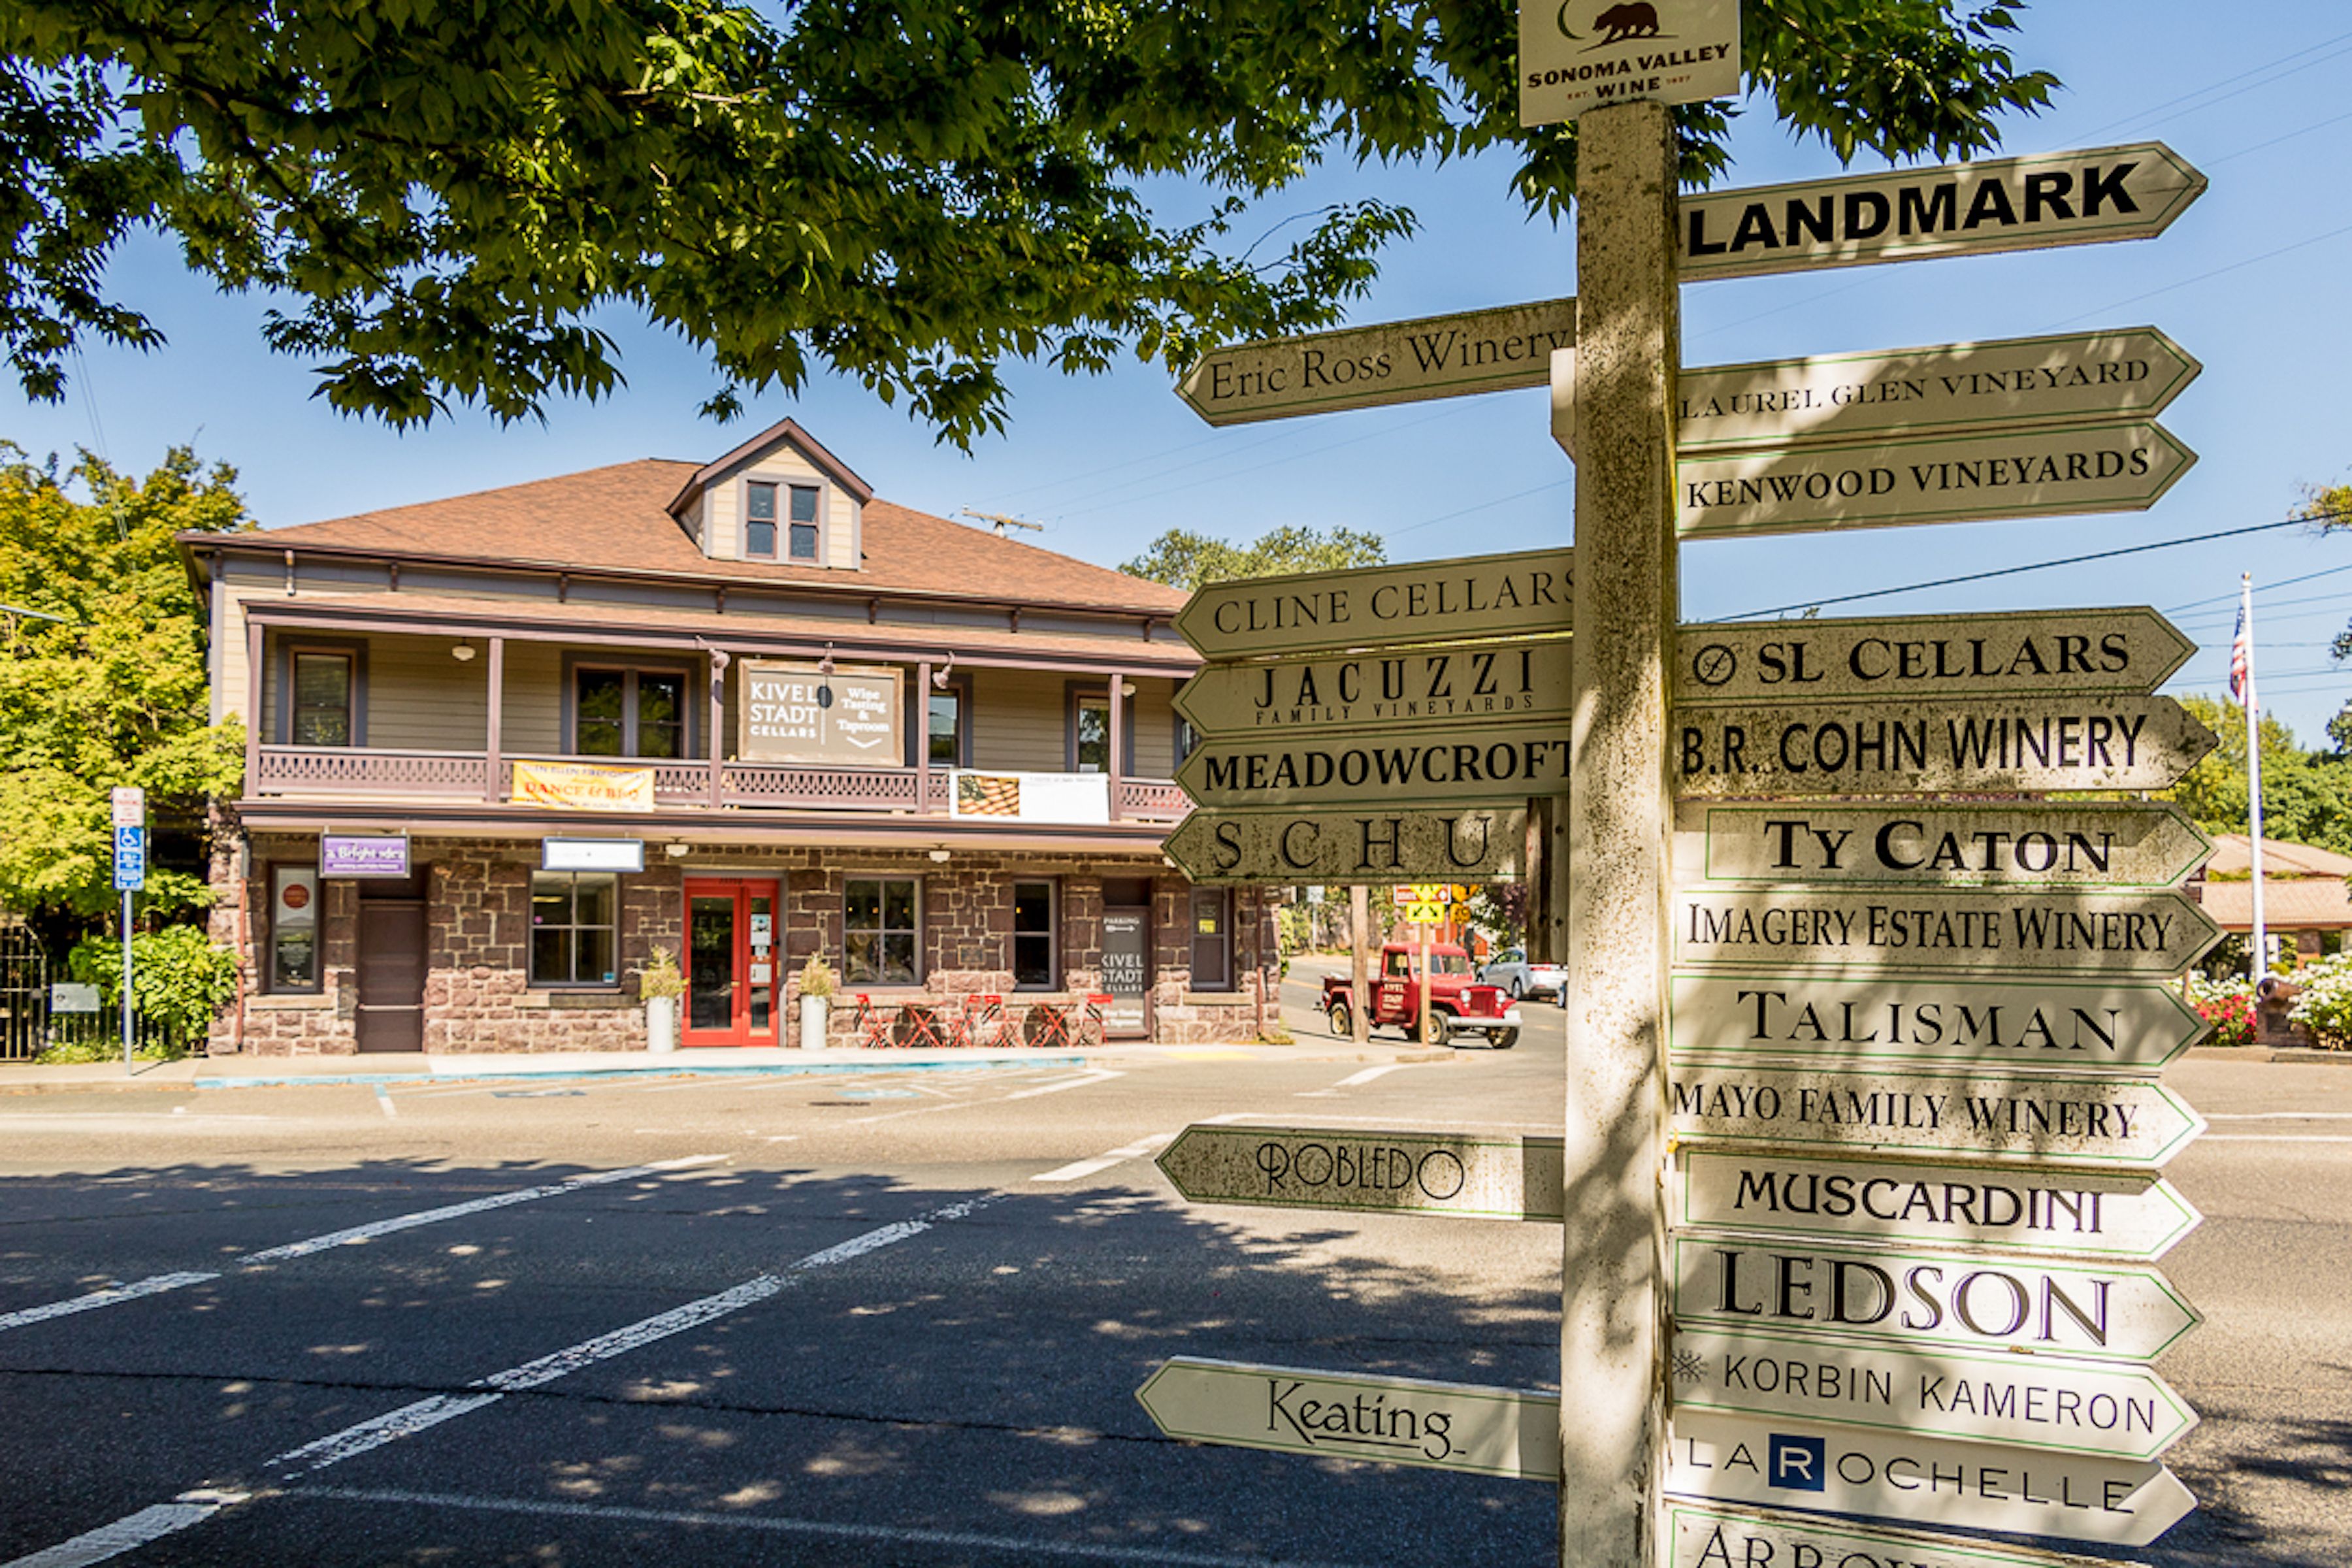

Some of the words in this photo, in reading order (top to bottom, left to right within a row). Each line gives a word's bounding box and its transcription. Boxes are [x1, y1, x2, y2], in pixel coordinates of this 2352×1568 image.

[1527, 59, 1631, 88] SONOMA
[1637, 43, 1730, 71] VALLEY
[1595, 76, 1660, 99] WINE
[1688, 162, 2142, 257] LANDMARK
[1211, 361, 1288, 400] Eric
[1301, 350, 1392, 388] Ross
[1681, 389, 1822, 419] LAUREL
[1832, 379, 1925, 406] GLEN
[1939, 360, 2149, 396] VINEYARD
[1688, 468, 1895, 508] KENWOOD
[1911, 448, 2149, 491] VINEYARDS
[1214, 591, 1350, 634] CLINE
[1254, 650, 1533, 708] JACUZZI
[1757, 642, 1825, 683] SL
[1850, 633, 2130, 679] CELLARS
[751, 682, 818, 702] KIVEL
[751, 704, 818, 723] STADT
[840, 698, 887, 713] Tasting
[847, 688, 879, 700] Wine
[1256, 706, 1352, 725] FAMILY
[1374, 695, 1533, 717] VINEYARDS
[751, 725, 816, 738] CELLARS
[836, 719, 889, 734] Taproom
[1780, 720, 1927, 772] COHN
[1947, 715, 2147, 770] WINERY
[524, 781, 584, 795] DANCE
[1204, 740, 1570, 791] MEADOWCROFT
[1764, 821, 1853, 870] TY
[1874, 821, 2115, 872] CATON
[1688, 903, 1855, 946] IMAGERY
[1868, 905, 2001, 949] ESTATE
[2012, 909, 2173, 951] WINERY
[1738, 991, 2123, 1051] TALISMAN
[1673, 1082, 1780, 1120] MAYO
[1798, 1088, 1948, 1128] FAMILY
[1966, 1098, 2138, 1137] WINERY
[1257, 1143, 1464, 1199] ROBLEDO
[1734, 1171, 2103, 1233] MUSCARDINI
[1713, 1250, 2116, 1346] LEDSON
[1724, 1354, 1892, 1405] KORBIN
[1920, 1375, 2155, 1433] KAMERON
[1267, 1380, 1452, 1459] Keating
[1690, 1438, 1759, 1473] LA
[1779, 1446, 2134, 1514] ROCHELLE
